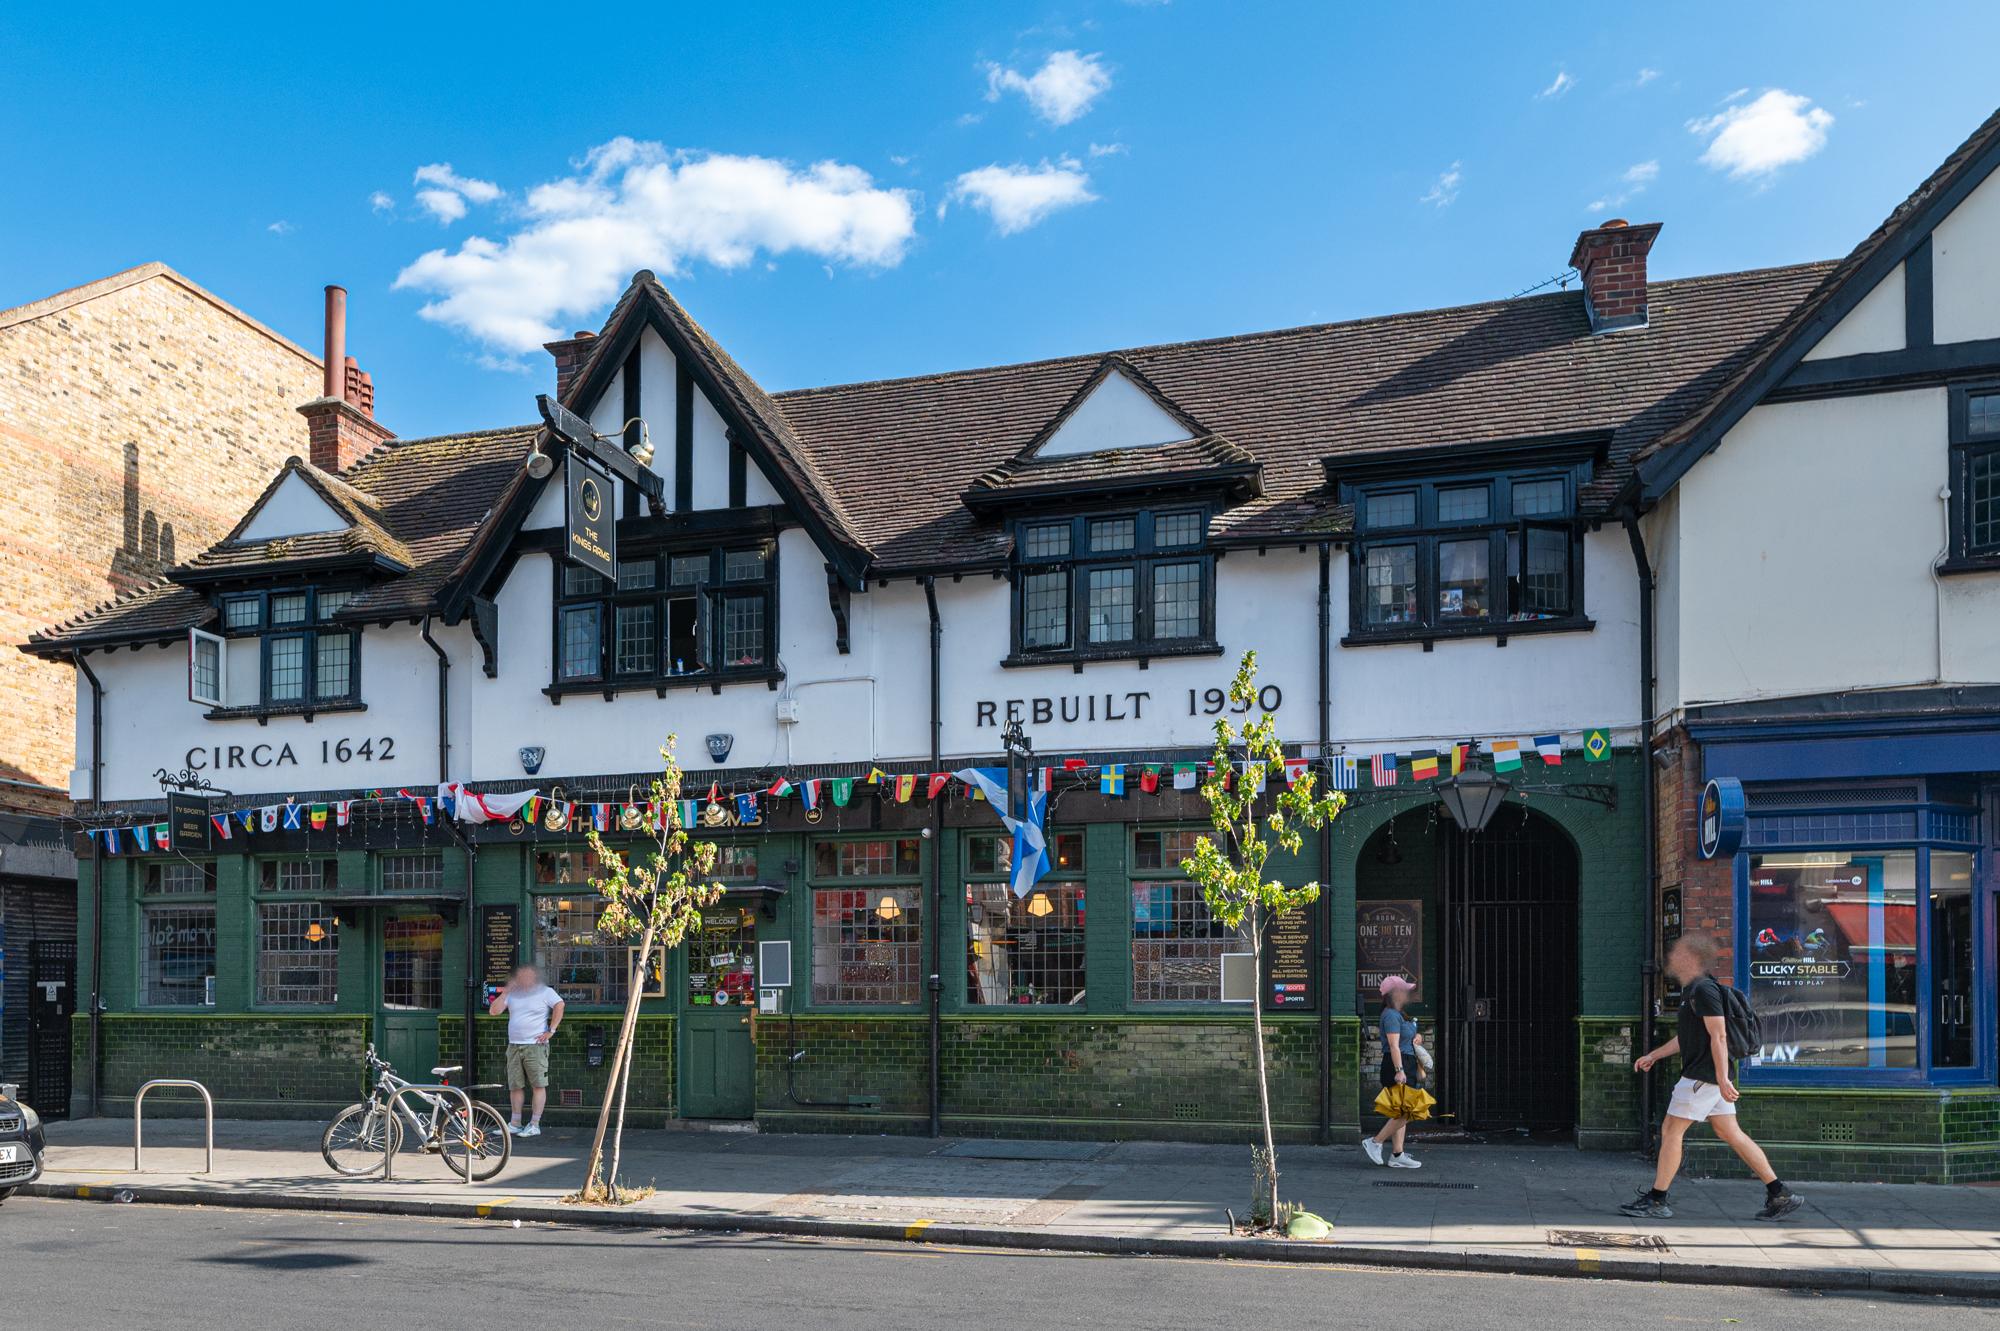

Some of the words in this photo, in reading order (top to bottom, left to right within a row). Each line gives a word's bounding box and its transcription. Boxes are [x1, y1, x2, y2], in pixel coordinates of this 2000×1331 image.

[585, 527, 598, 542] THE
[572, 532, 592, 552] KINGS
[592, 545, 611, 562] ARMS
[977, 692, 1150, 727] REBUILT
[186, 742, 298, 770] CIRCA
[322, 737, 395, 763] 1642
[184, 807, 206, 816] SPORTS
[183, 822, 199, 830] BEER
[1704, 815, 1717, 845] HILL
[179, 830, 203, 839] GARDEN
[1360, 925, 1378, 936] ONE
[1394, 925, 1412, 936] TEN
[1760, 965, 1795, 974] LUCKY
[1797, 965, 1838, 974] STABLE
[1361, 973, 1384, 988] THIS
